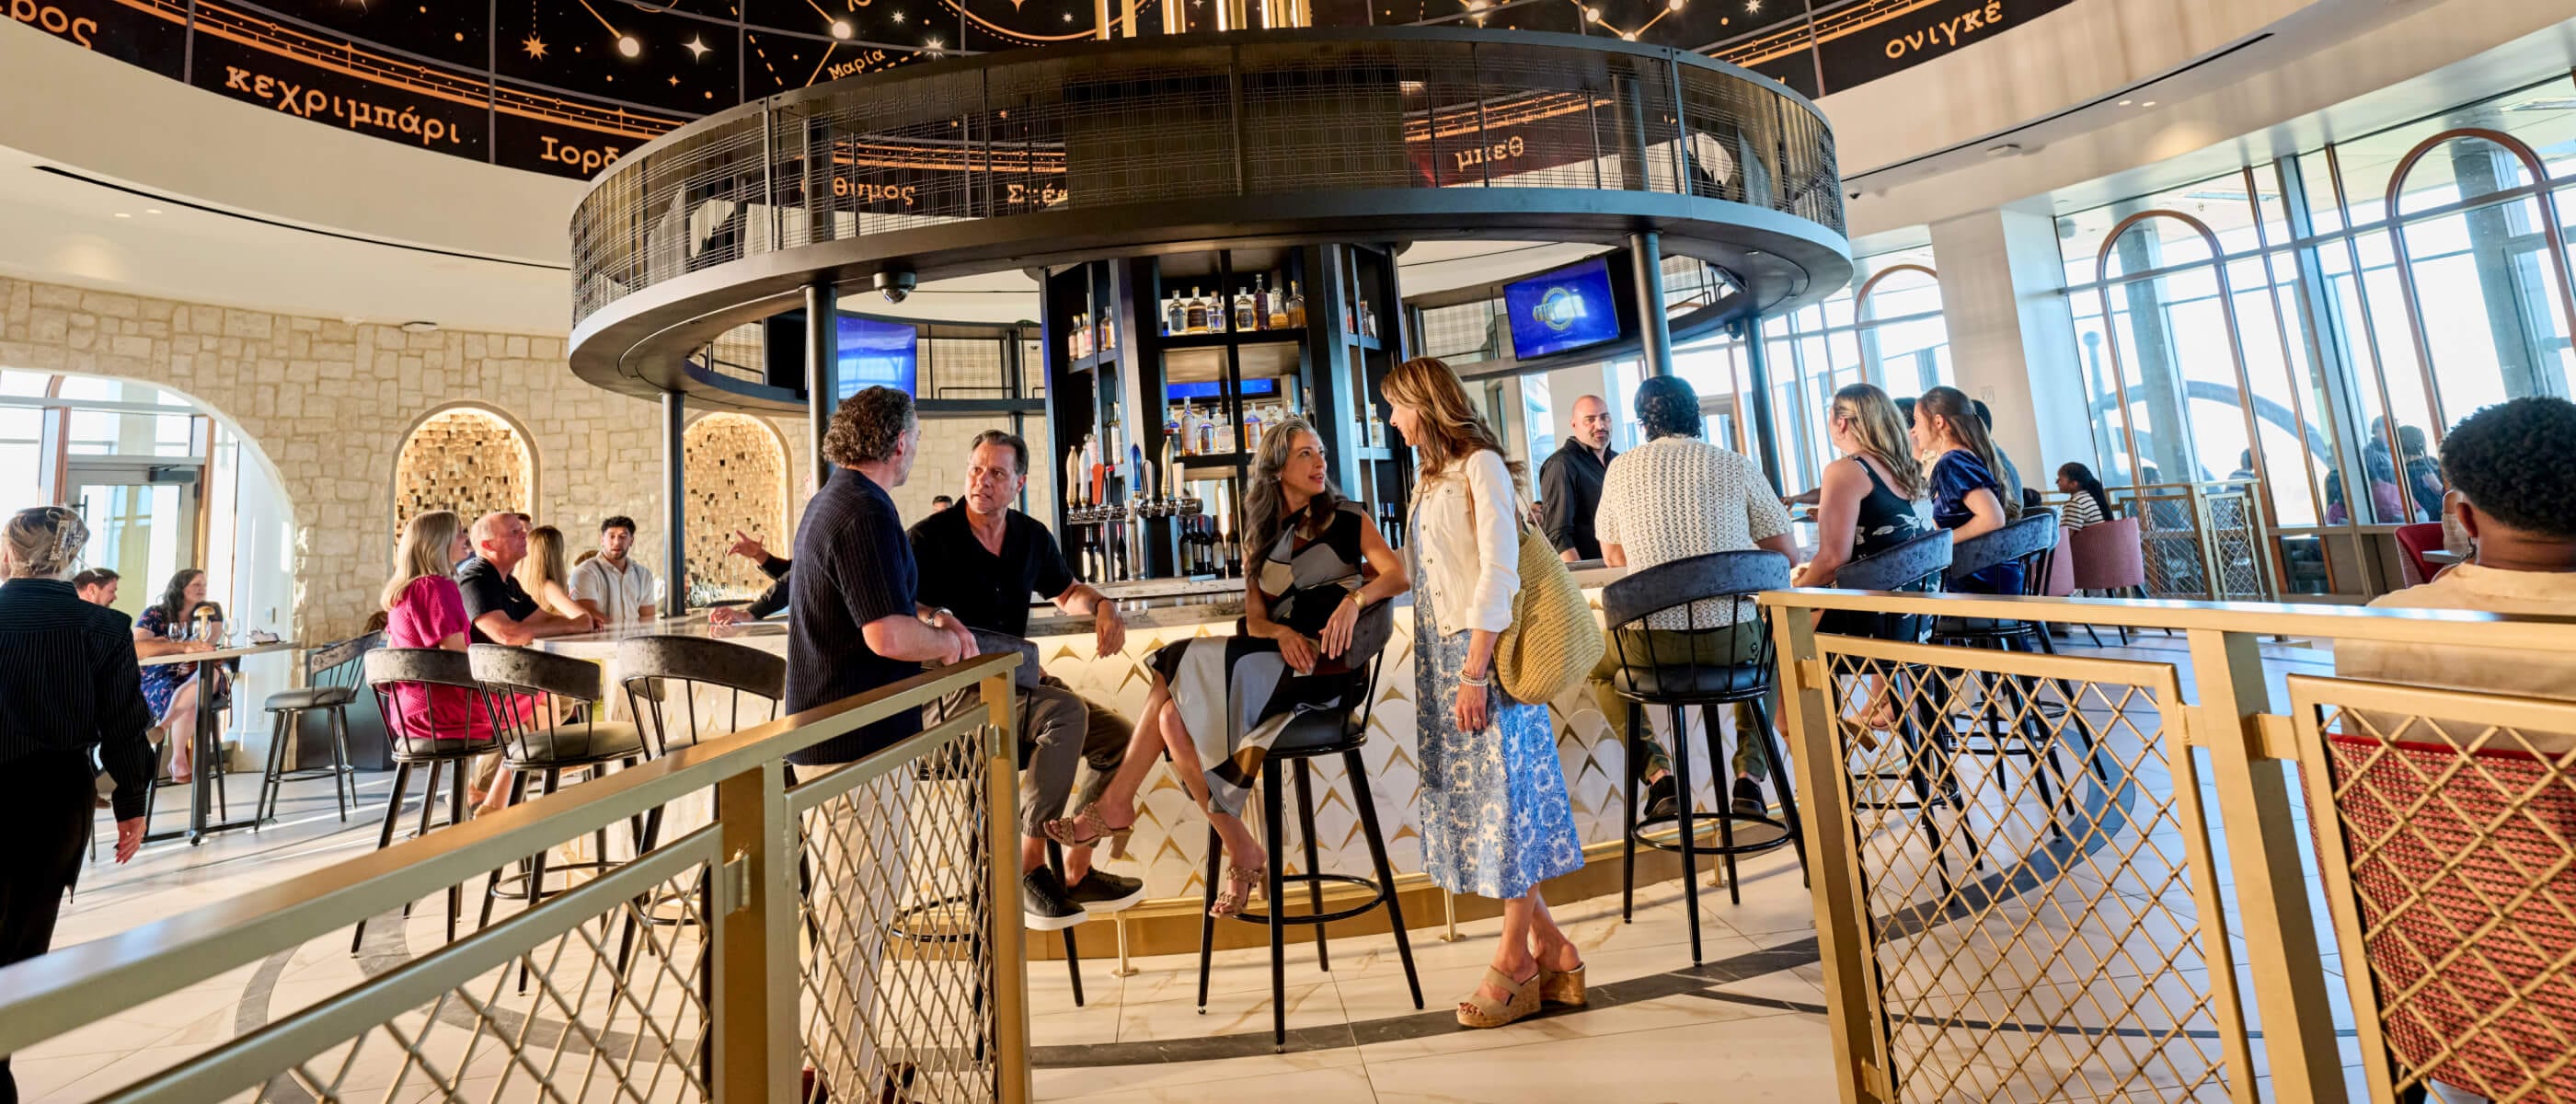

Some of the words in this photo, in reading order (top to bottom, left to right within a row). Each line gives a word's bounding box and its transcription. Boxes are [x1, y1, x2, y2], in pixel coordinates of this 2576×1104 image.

[0, 0, 97, 50] ρος
[1886, 0, 2003, 58] ονιγκέ
[827, 49, 886, 81] Μαρία
[225, 65, 460, 145] κεχριμπάρι
